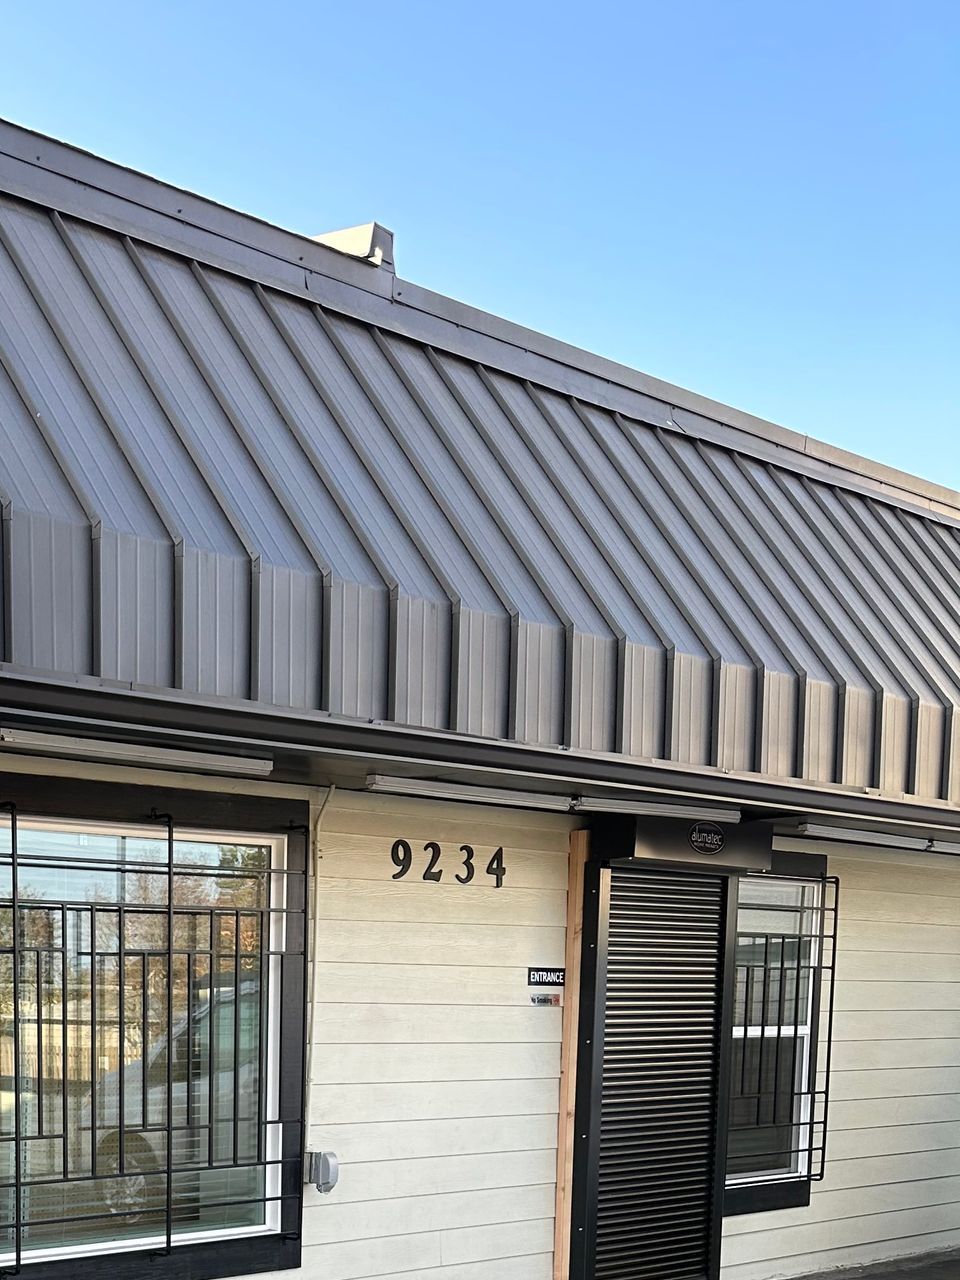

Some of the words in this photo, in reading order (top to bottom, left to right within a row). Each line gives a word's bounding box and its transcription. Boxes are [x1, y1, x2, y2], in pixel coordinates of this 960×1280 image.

[691, 825, 722, 845] alumatec
[390, 839, 506, 888] 9234
[530, 971, 564, 983] ENTRANCE
